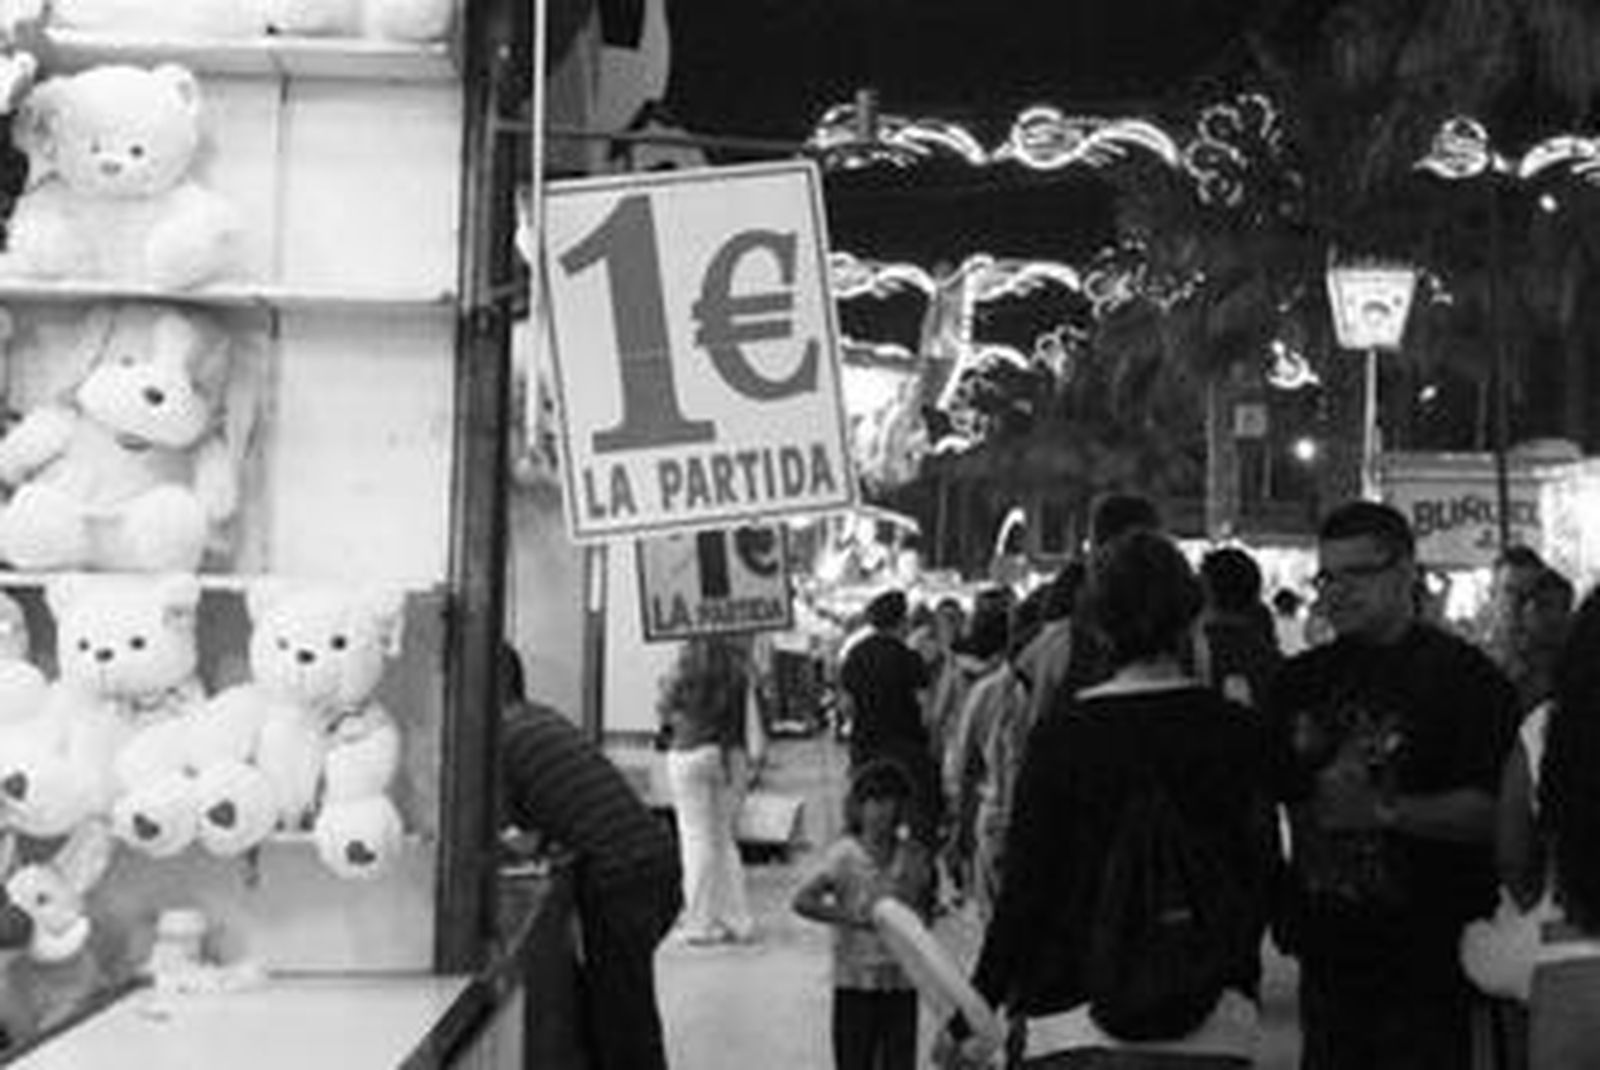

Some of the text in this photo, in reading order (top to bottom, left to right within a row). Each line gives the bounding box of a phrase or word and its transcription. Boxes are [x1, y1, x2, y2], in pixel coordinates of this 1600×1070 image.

[557, 193, 820, 454] 1€
[584, 444, 836, 518] LA PARTIDA
[654, 594, 692, 631] LA
